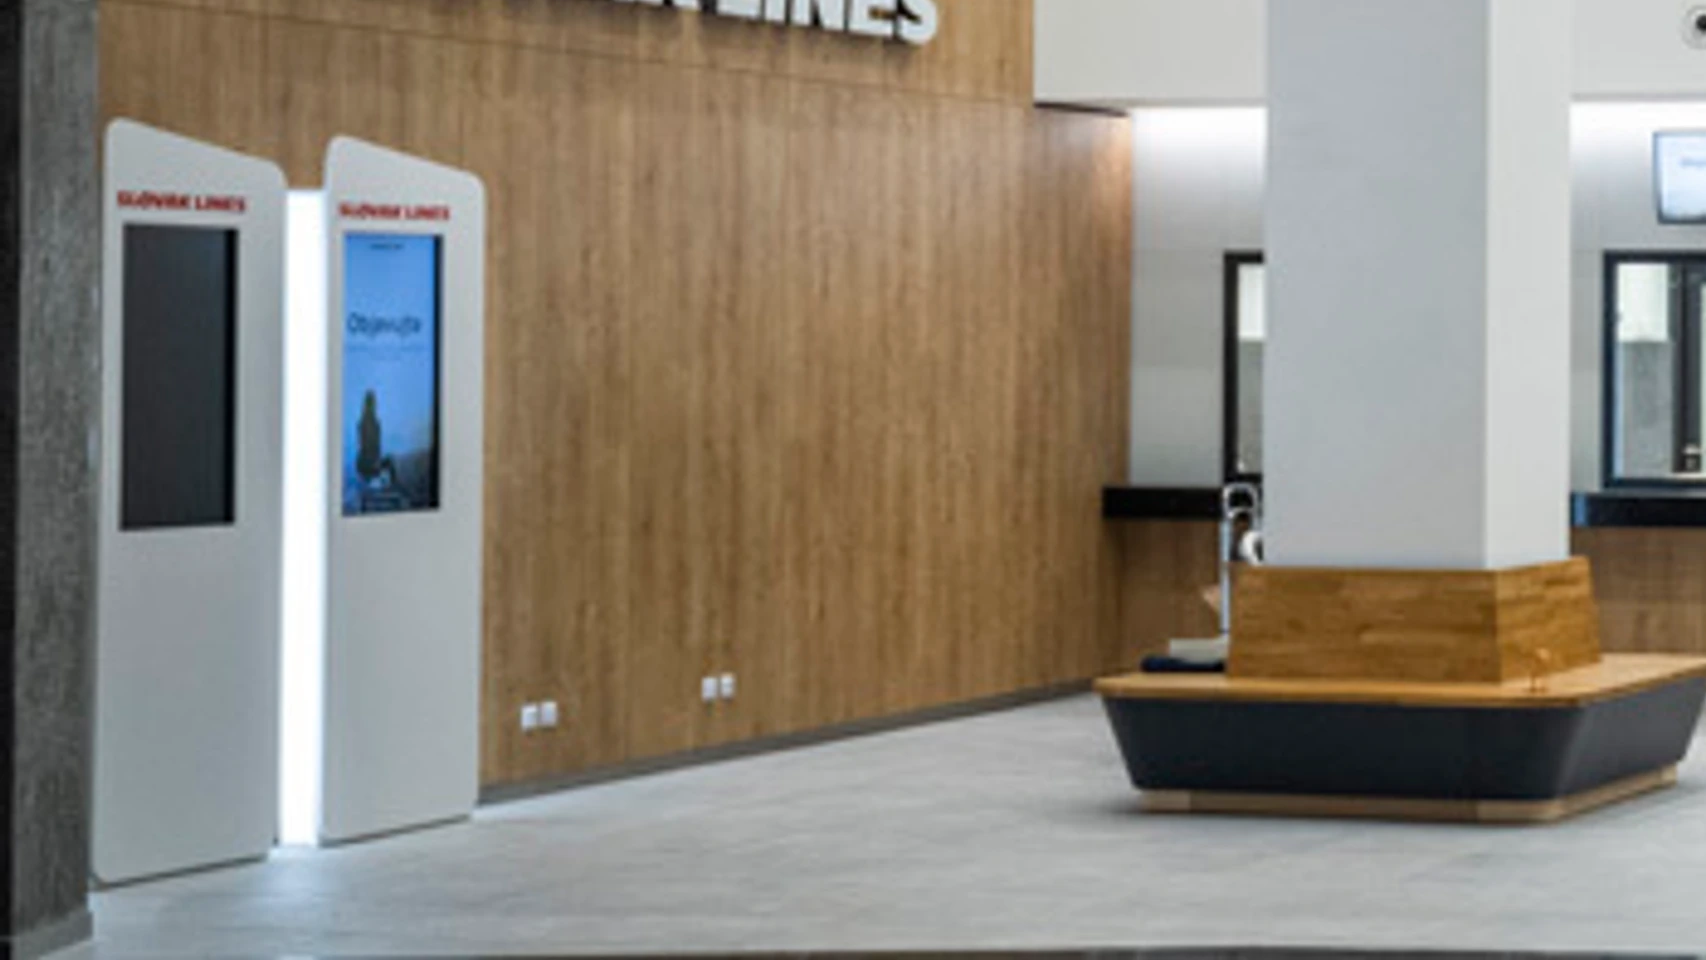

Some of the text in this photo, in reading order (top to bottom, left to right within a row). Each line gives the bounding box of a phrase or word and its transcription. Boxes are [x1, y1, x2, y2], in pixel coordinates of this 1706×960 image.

[117, 190, 246, 213] SLOVAK LINES
[339, 202, 450, 221] SLOVAK LINES
